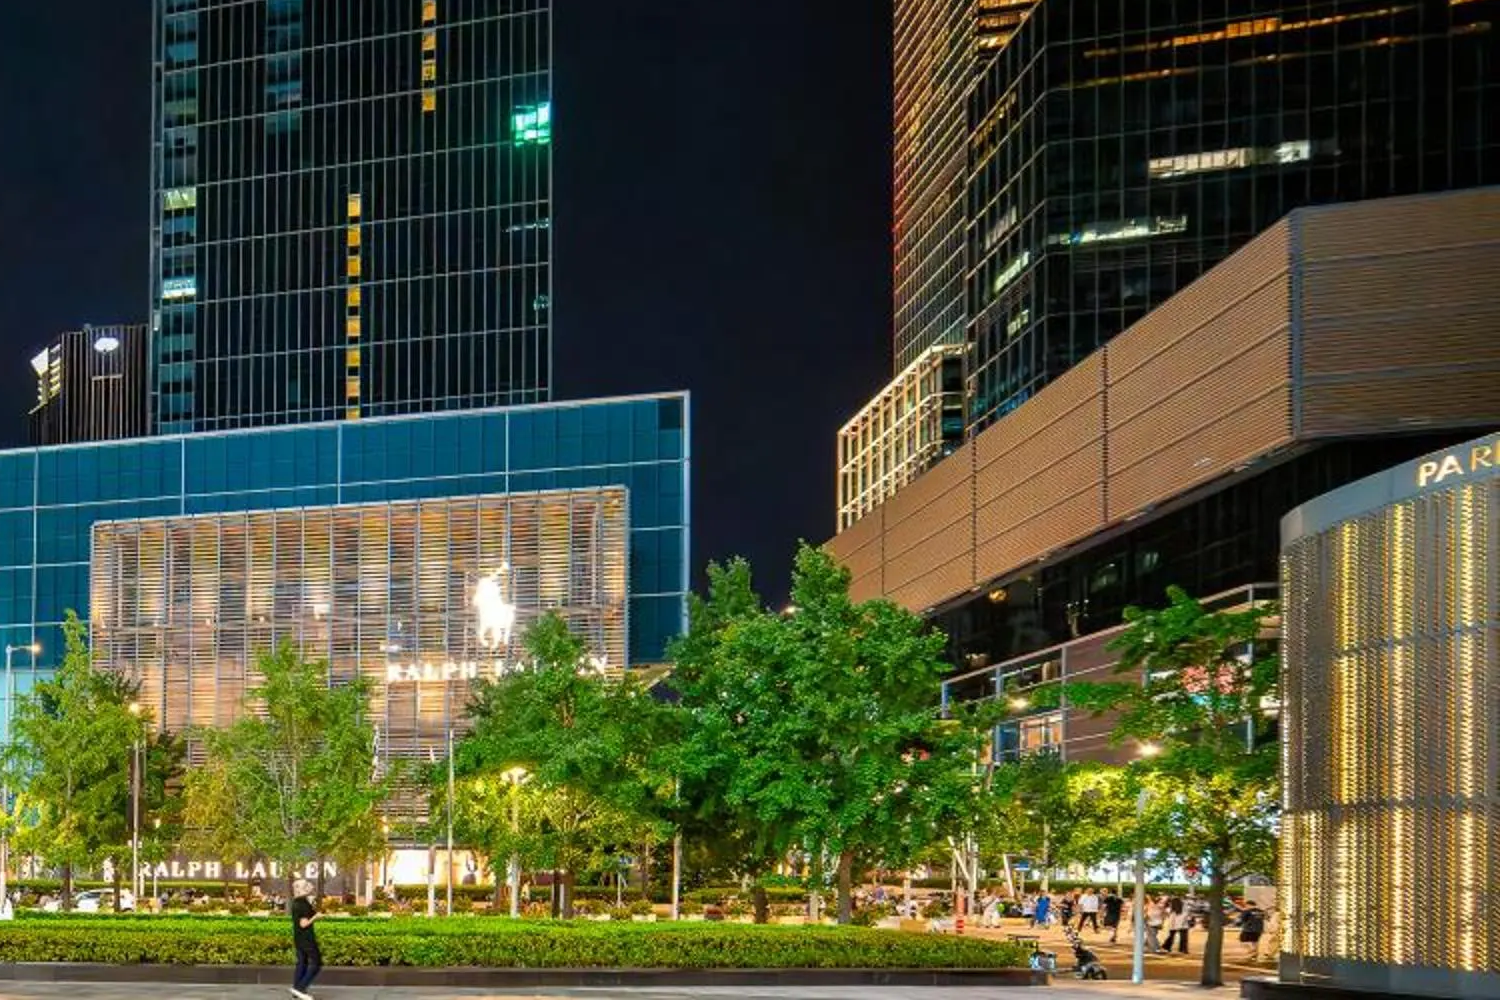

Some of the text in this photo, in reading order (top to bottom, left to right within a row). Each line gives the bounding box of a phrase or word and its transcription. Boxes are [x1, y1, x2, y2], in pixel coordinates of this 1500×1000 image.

[387, 660, 476, 681] RALPH
[138, 860, 337, 879] RALPH LAUEN
